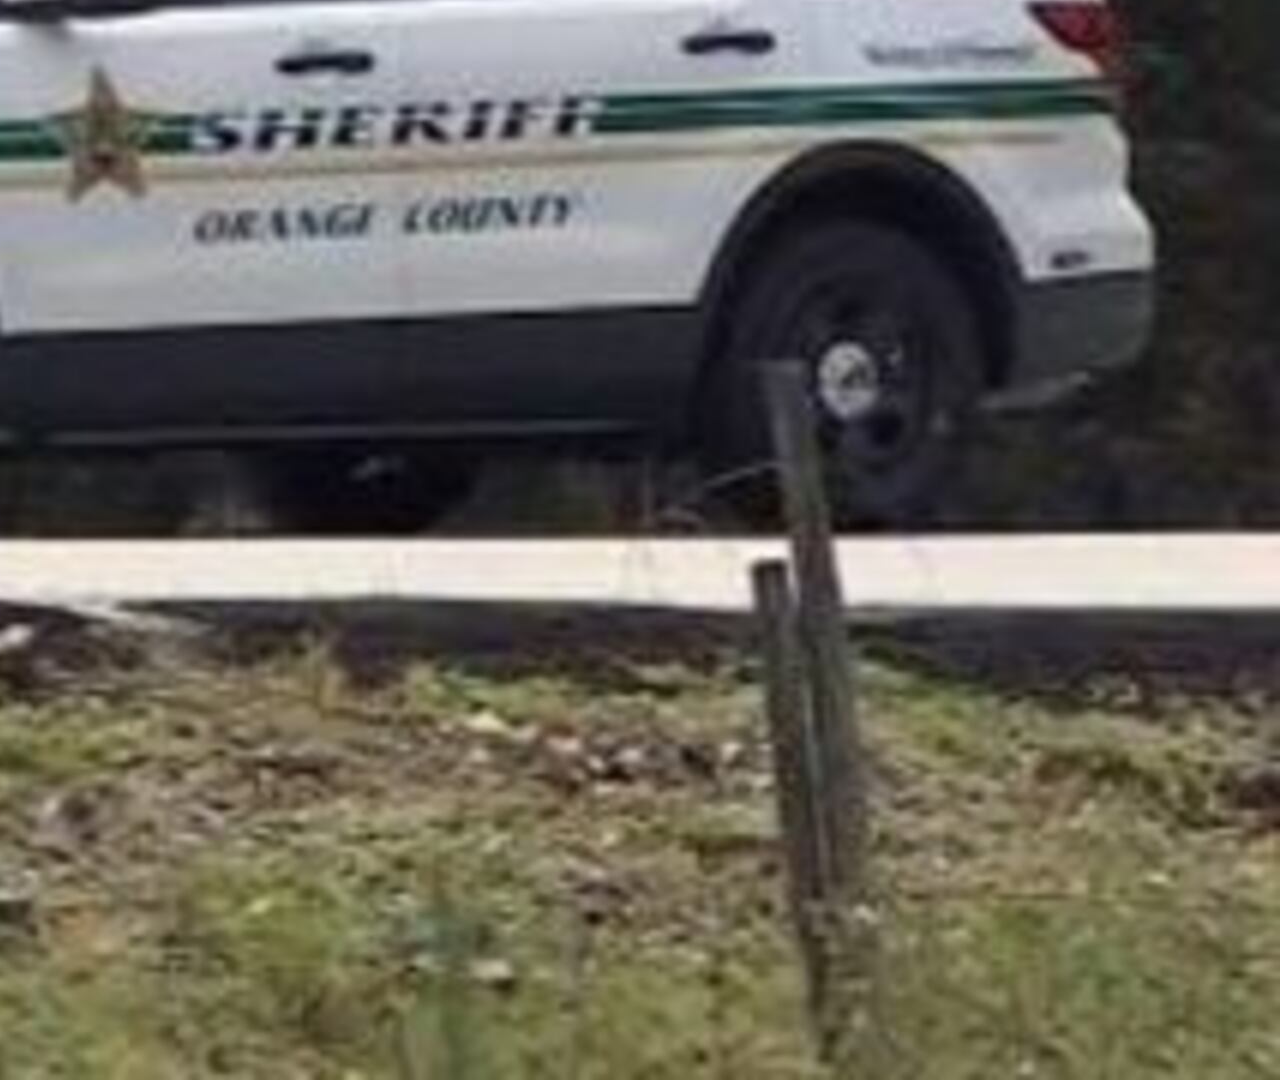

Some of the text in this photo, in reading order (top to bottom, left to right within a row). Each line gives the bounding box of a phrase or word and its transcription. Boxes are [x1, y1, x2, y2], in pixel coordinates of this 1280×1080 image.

[186, 95, 602, 153] SHERIFF
[193, 191, 577, 244] ORANGE COUNTY
